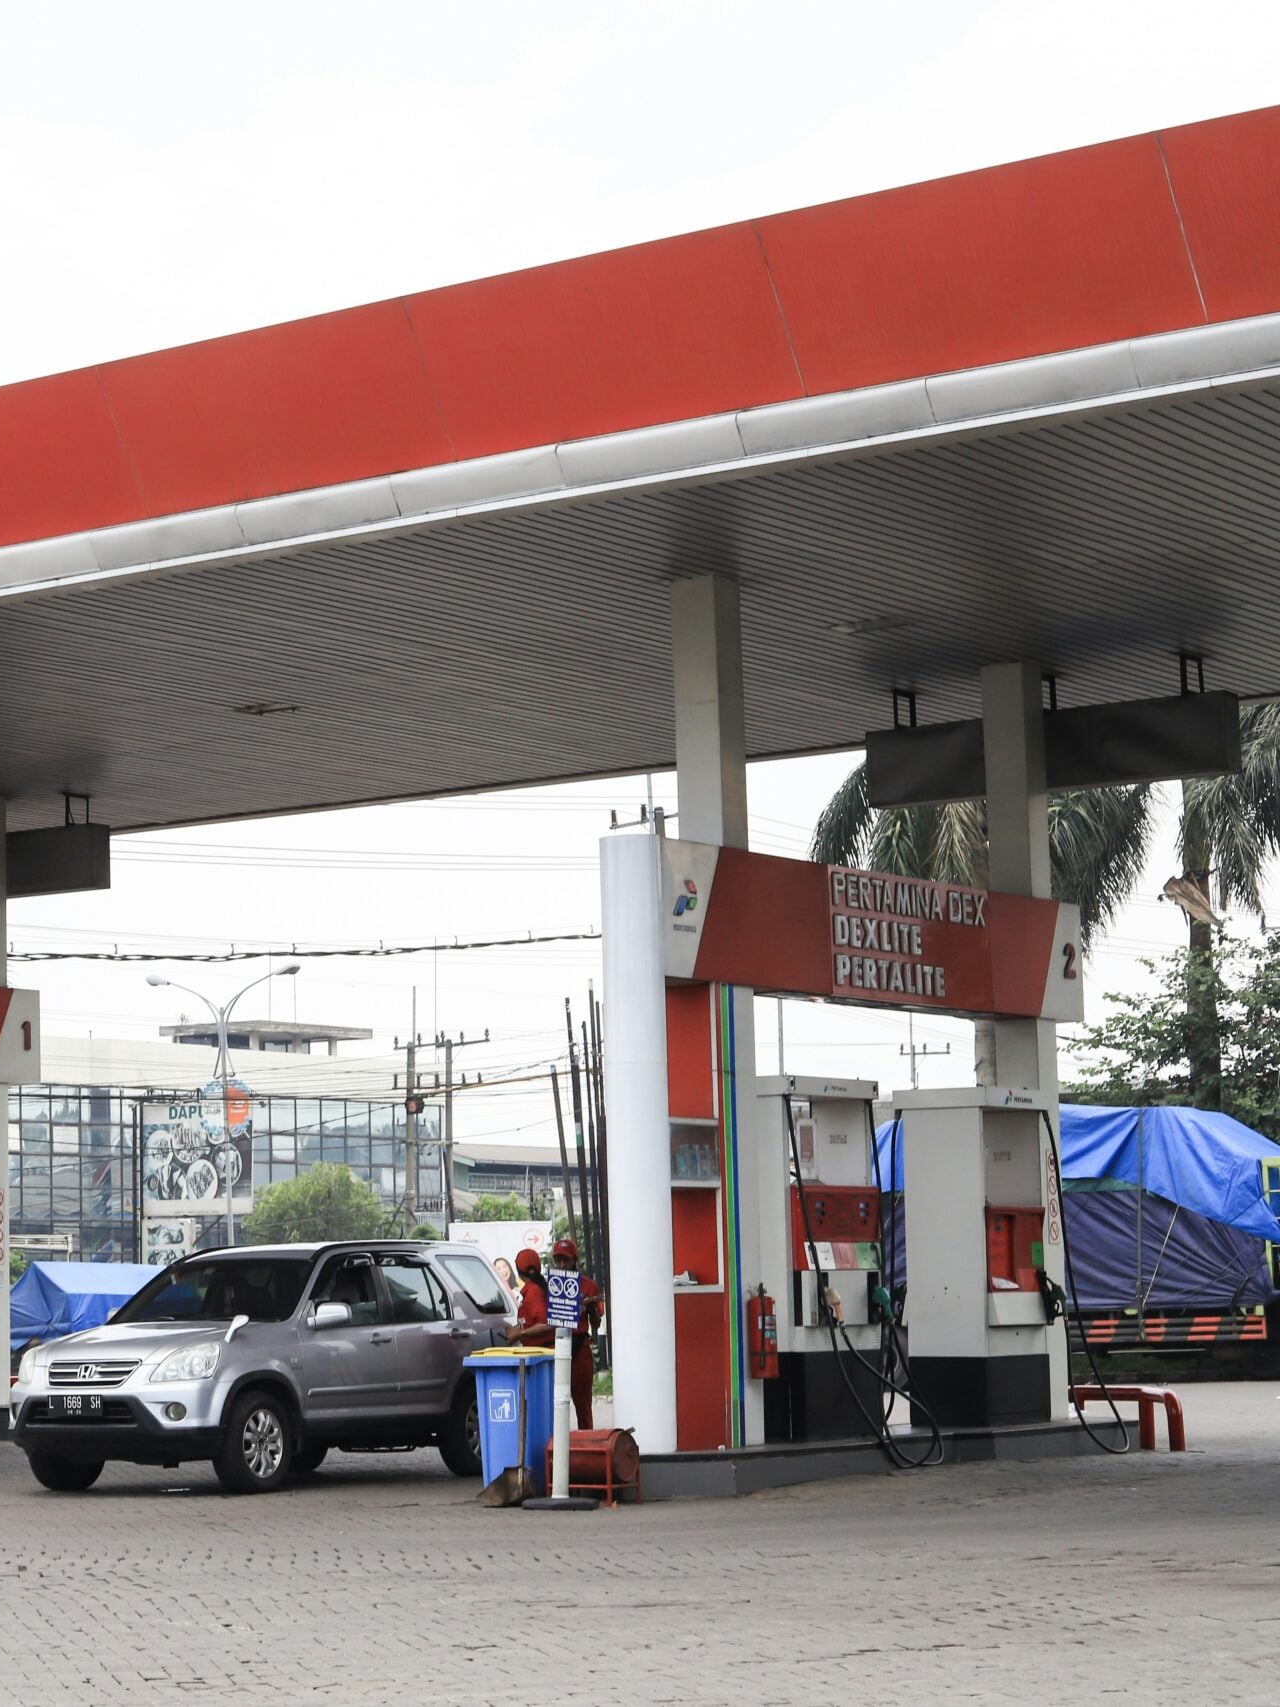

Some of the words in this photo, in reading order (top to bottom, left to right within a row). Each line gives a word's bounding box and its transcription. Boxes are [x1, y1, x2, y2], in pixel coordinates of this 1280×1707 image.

[832, 871, 943, 922] PERTAMINA
[949, 891, 987, 927] DEX
[834, 913, 922, 955] DEXLITE
[835, 953, 946, 997] PERTALITE
[1063, 943, 1077, 980] 2
[21, 1020, 32, 1052] 1
[48, 1396, 54, 1409] L
[63, 1396, 82, 1409] 1669
[90, 1395, 101, 1409] SH
